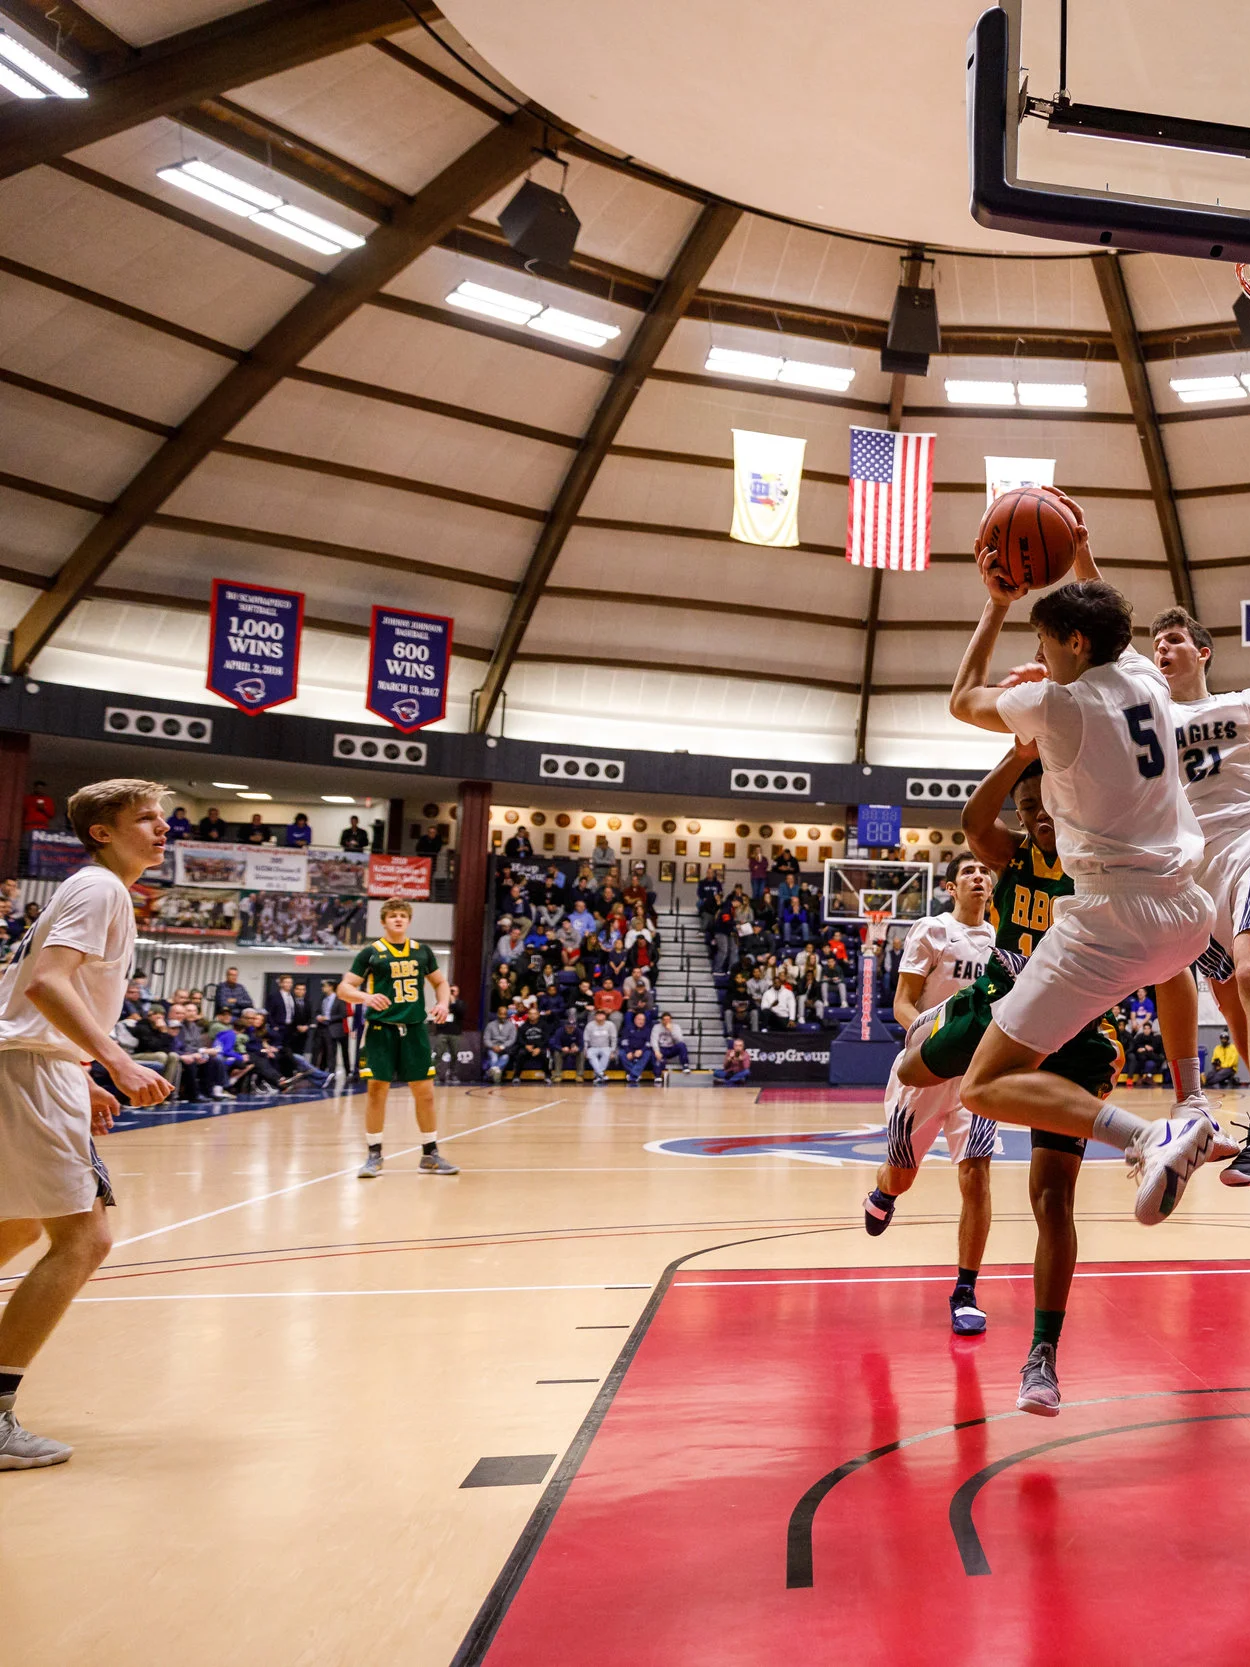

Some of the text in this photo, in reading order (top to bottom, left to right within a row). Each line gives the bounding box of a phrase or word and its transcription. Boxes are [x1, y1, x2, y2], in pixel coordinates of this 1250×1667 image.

[229, 616, 285, 640] 1,000
[227, 635, 284, 659] WINS
[392, 641, 430, 662] 600
[385, 659, 436, 681] WINS
[1122, 702, 1165, 779] 5
[1175, 721, 1238, 750] AGLES
[1183, 746, 1222, 782] 21
[1019, 932, 1033, 958] 1
[389, 960, 419, 979] RBC
[953, 960, 985, 981] EAG
[393, 978, 419, 1004] 15
[861, 958, 873, 1041] BROOKDALE
